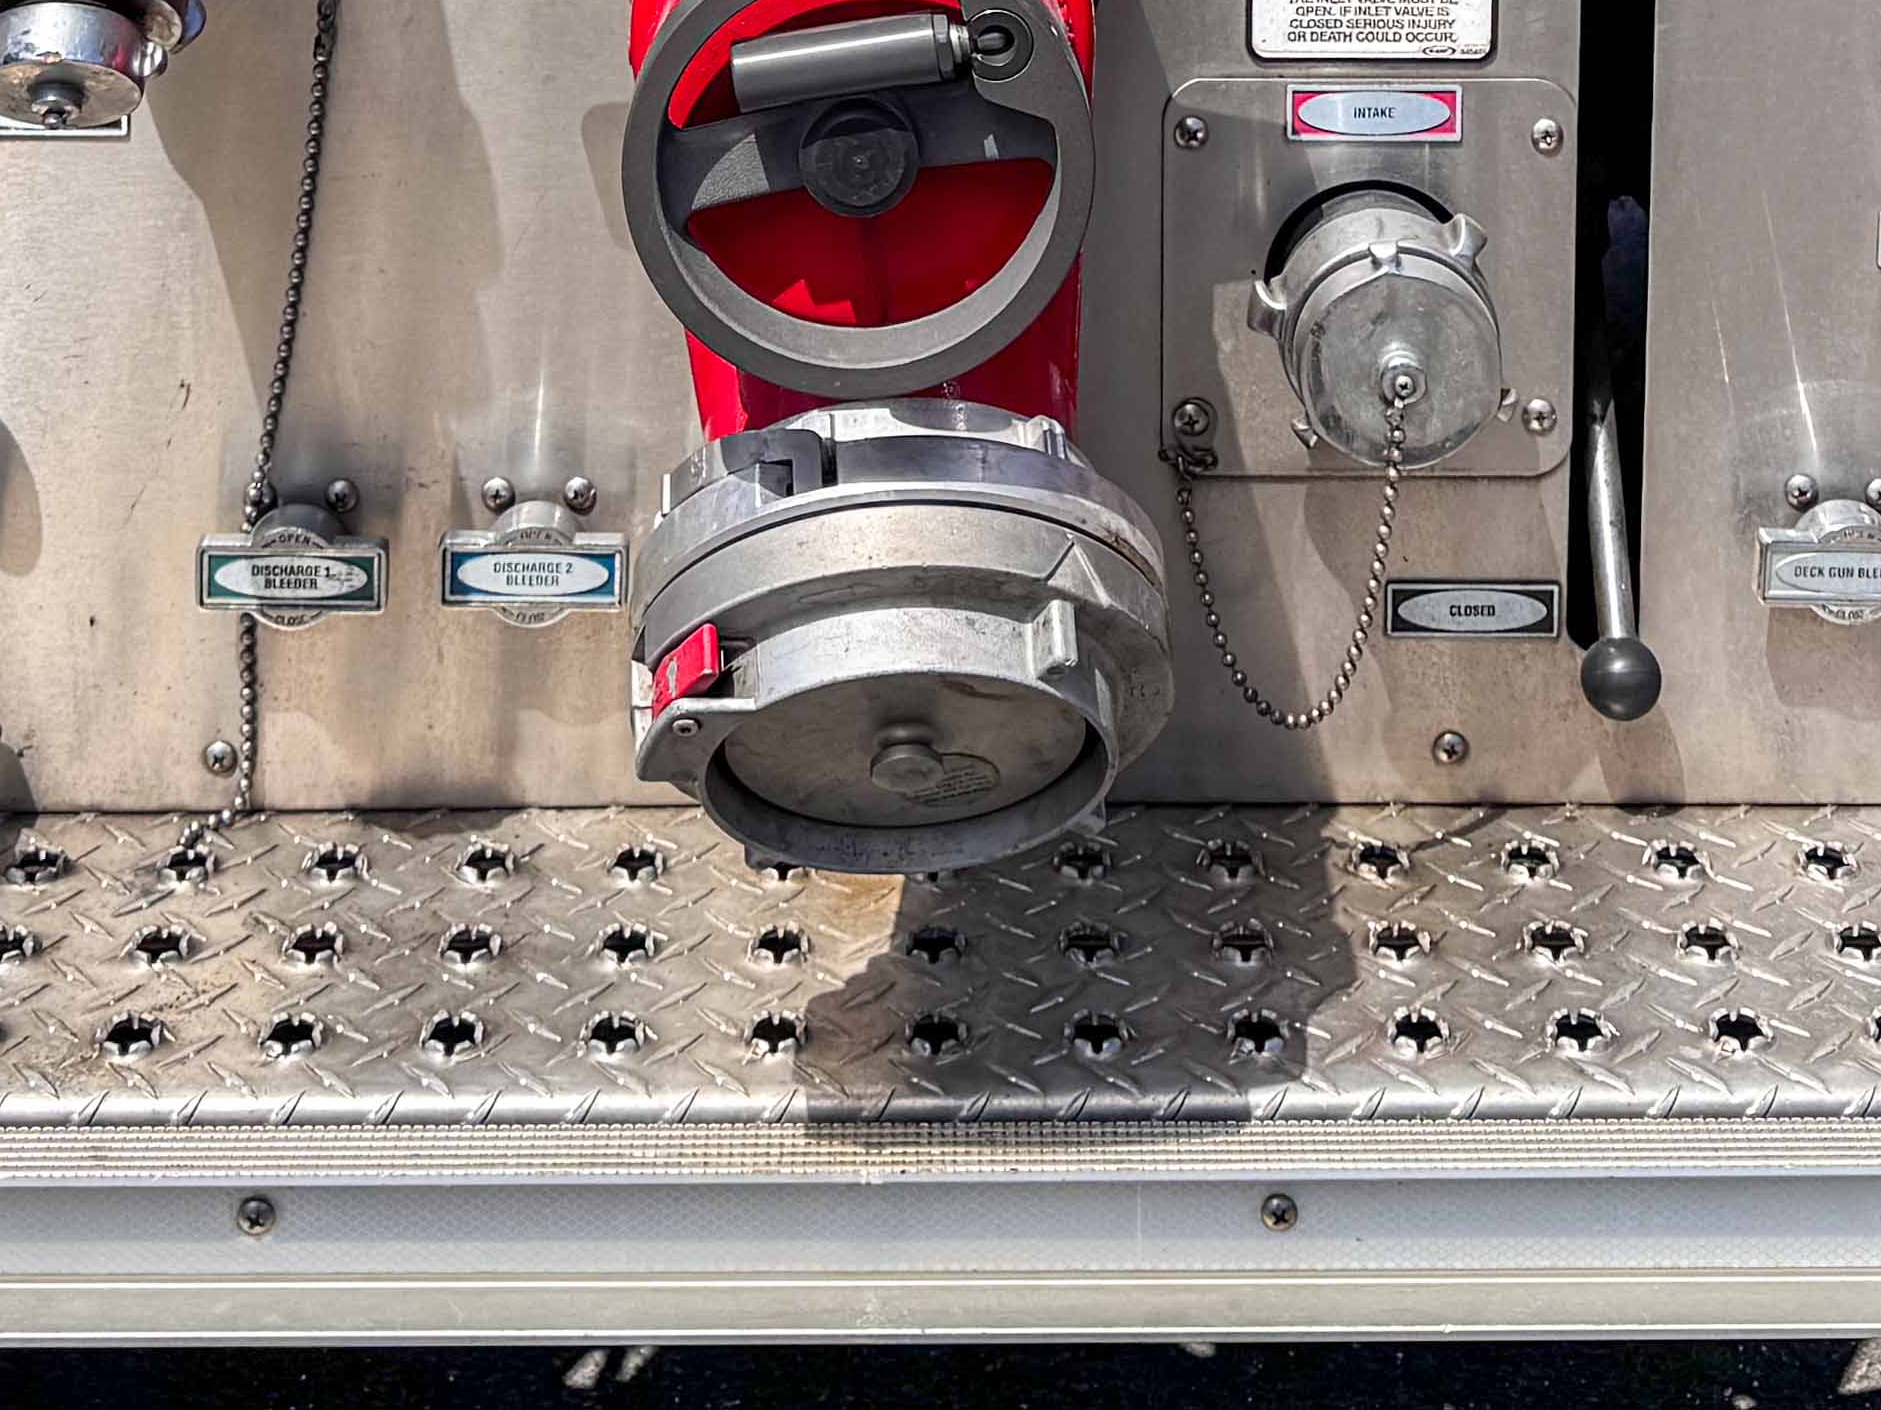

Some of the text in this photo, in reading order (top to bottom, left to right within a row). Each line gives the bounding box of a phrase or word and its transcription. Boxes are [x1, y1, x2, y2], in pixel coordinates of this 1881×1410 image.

[1289, 18, 1456, 29] CLOSED SERIOUS INJURY
[1353, 106, 1396, 119] INTAKE
[251, 564, 331, 578] DISCHARGE 1
[493, 562, 573, 574] DISCHARGE 2
[1793, 565, 1825, 578] DECK
[1828, 565, 1854, 578] GUN
[264, 577, 318, 589] BLEEDER
[506, 574, 560, 587] BLEEDER
[1449, 604, 1496, 617] CLOSED
